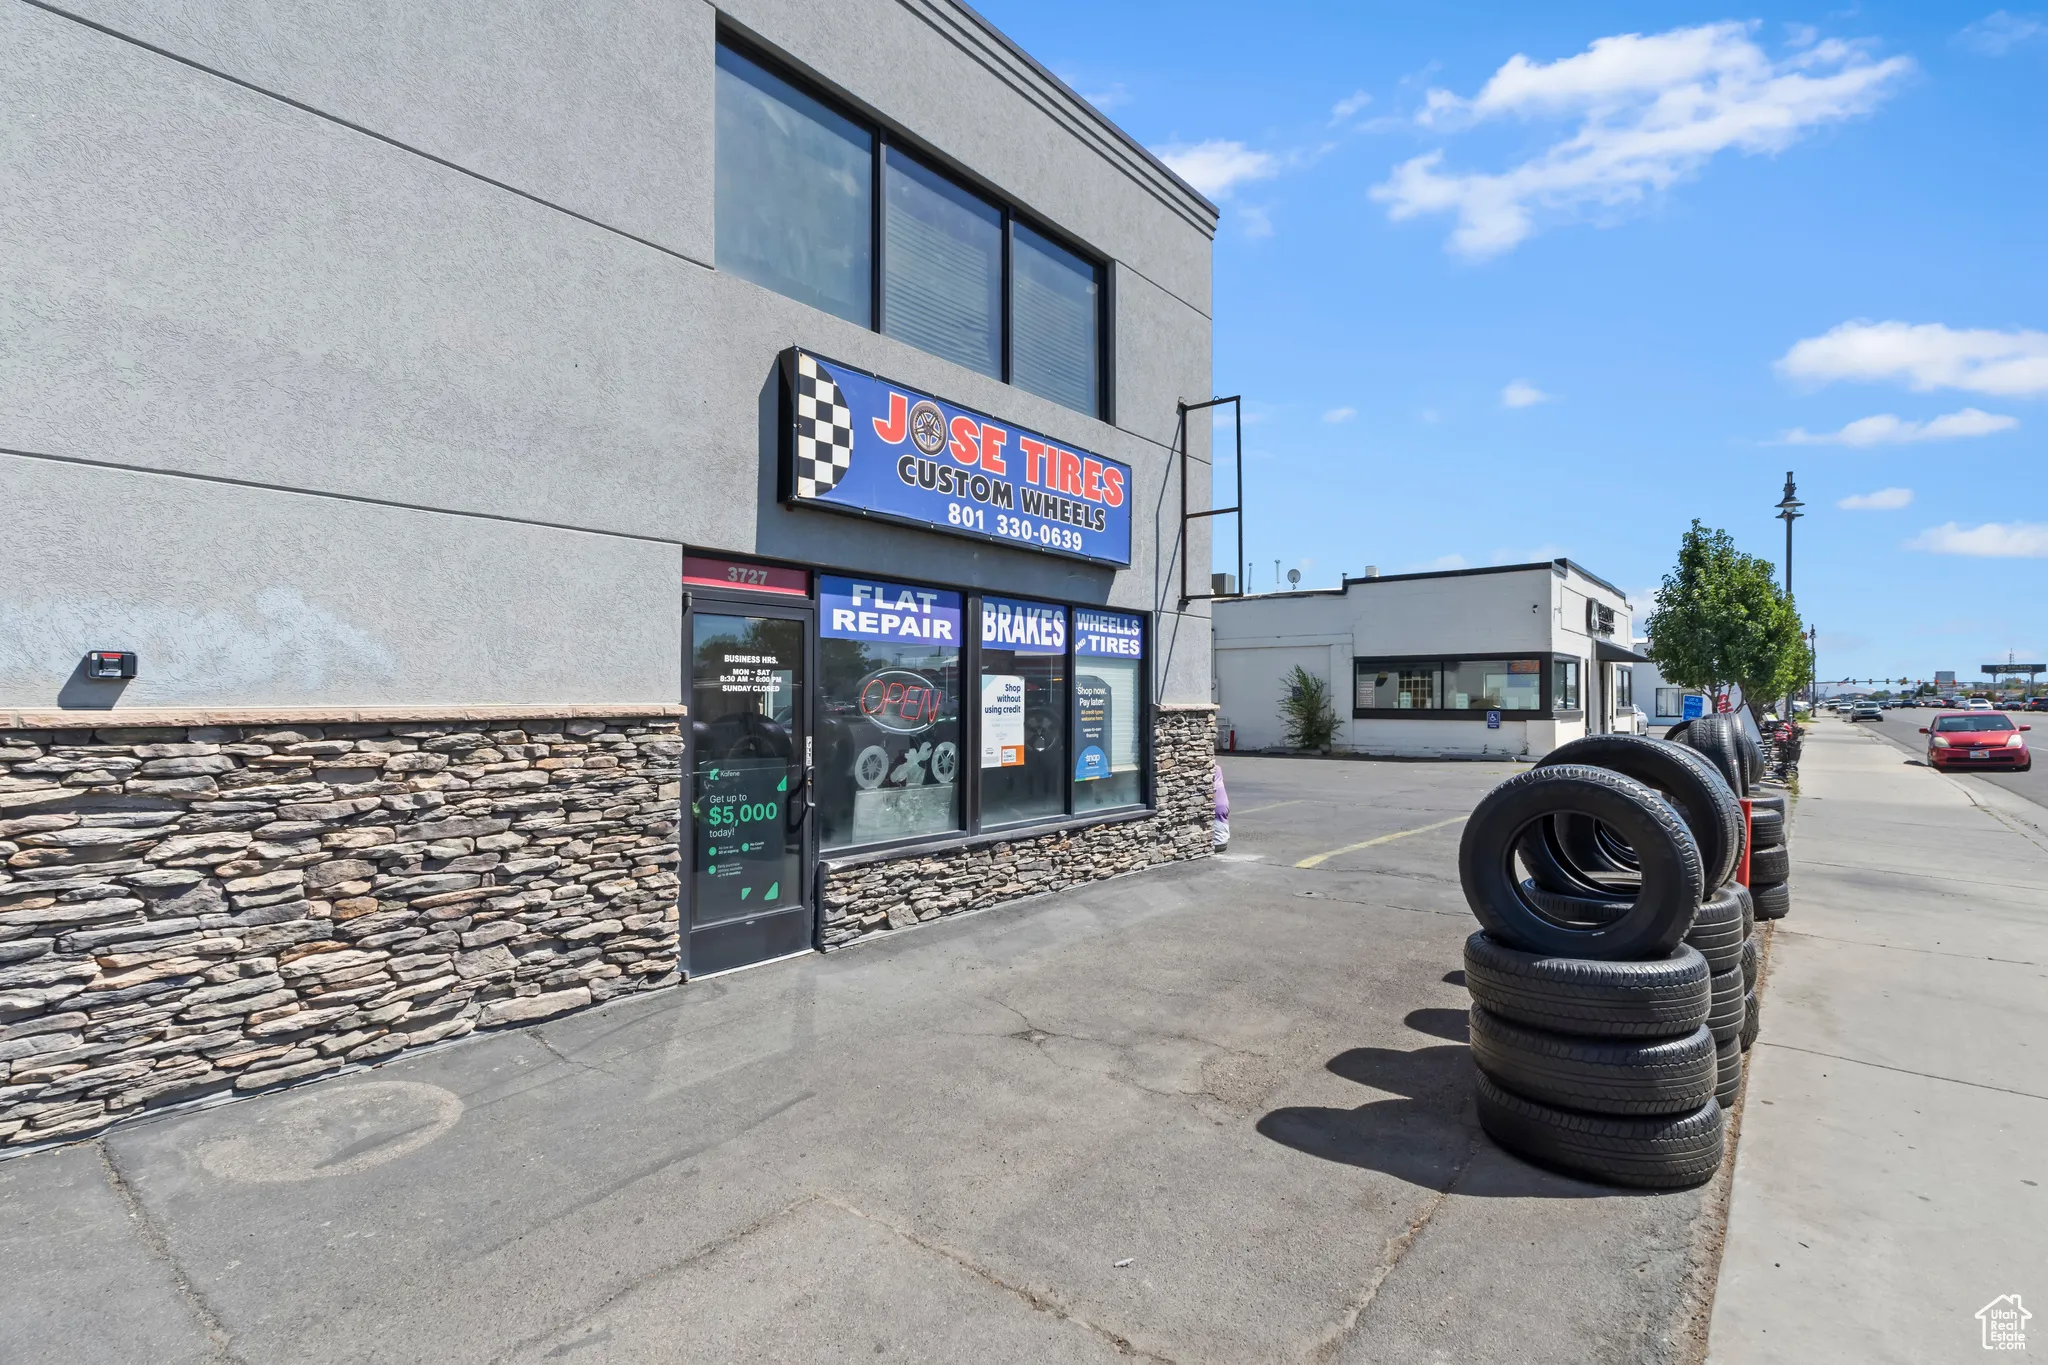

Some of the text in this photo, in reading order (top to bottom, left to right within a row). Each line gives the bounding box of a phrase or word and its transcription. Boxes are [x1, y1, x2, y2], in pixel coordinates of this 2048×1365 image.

[872, 392, 1124, 507] JOSE TIRES
[898, 455, 1106, 532] CUSTOM WHEELS
[949, 503, 1082, 551] 801 330-0639
[728, 566, 767, 586] 3727
[852, 584, 937, 614] FLAT
[832, 608, 952, 640] REPAIR
[982, 602, 1064, 647] BRAKES
[1077, 613, 1139, 636] WHEELLS
[1088, 635, 1139, 655] TIRES
[724, 654, 778, 664] BUSINESS HRS.
[997, 694, 1021, 702] without
[1005, 684, 1021, 693] Shop
[1078, 686, 1092, 696] Shop
[862, 680, 942, 722] OPEN
[985, 705, 1021, 715] using credit
[1080, 698, 1090, 708] Pay
[710, 795, 724, 803] Get
[727, 795, 736, 803] up
[709, 802, 777, 826] $5,000
[709, 828, 734, 838] today!
